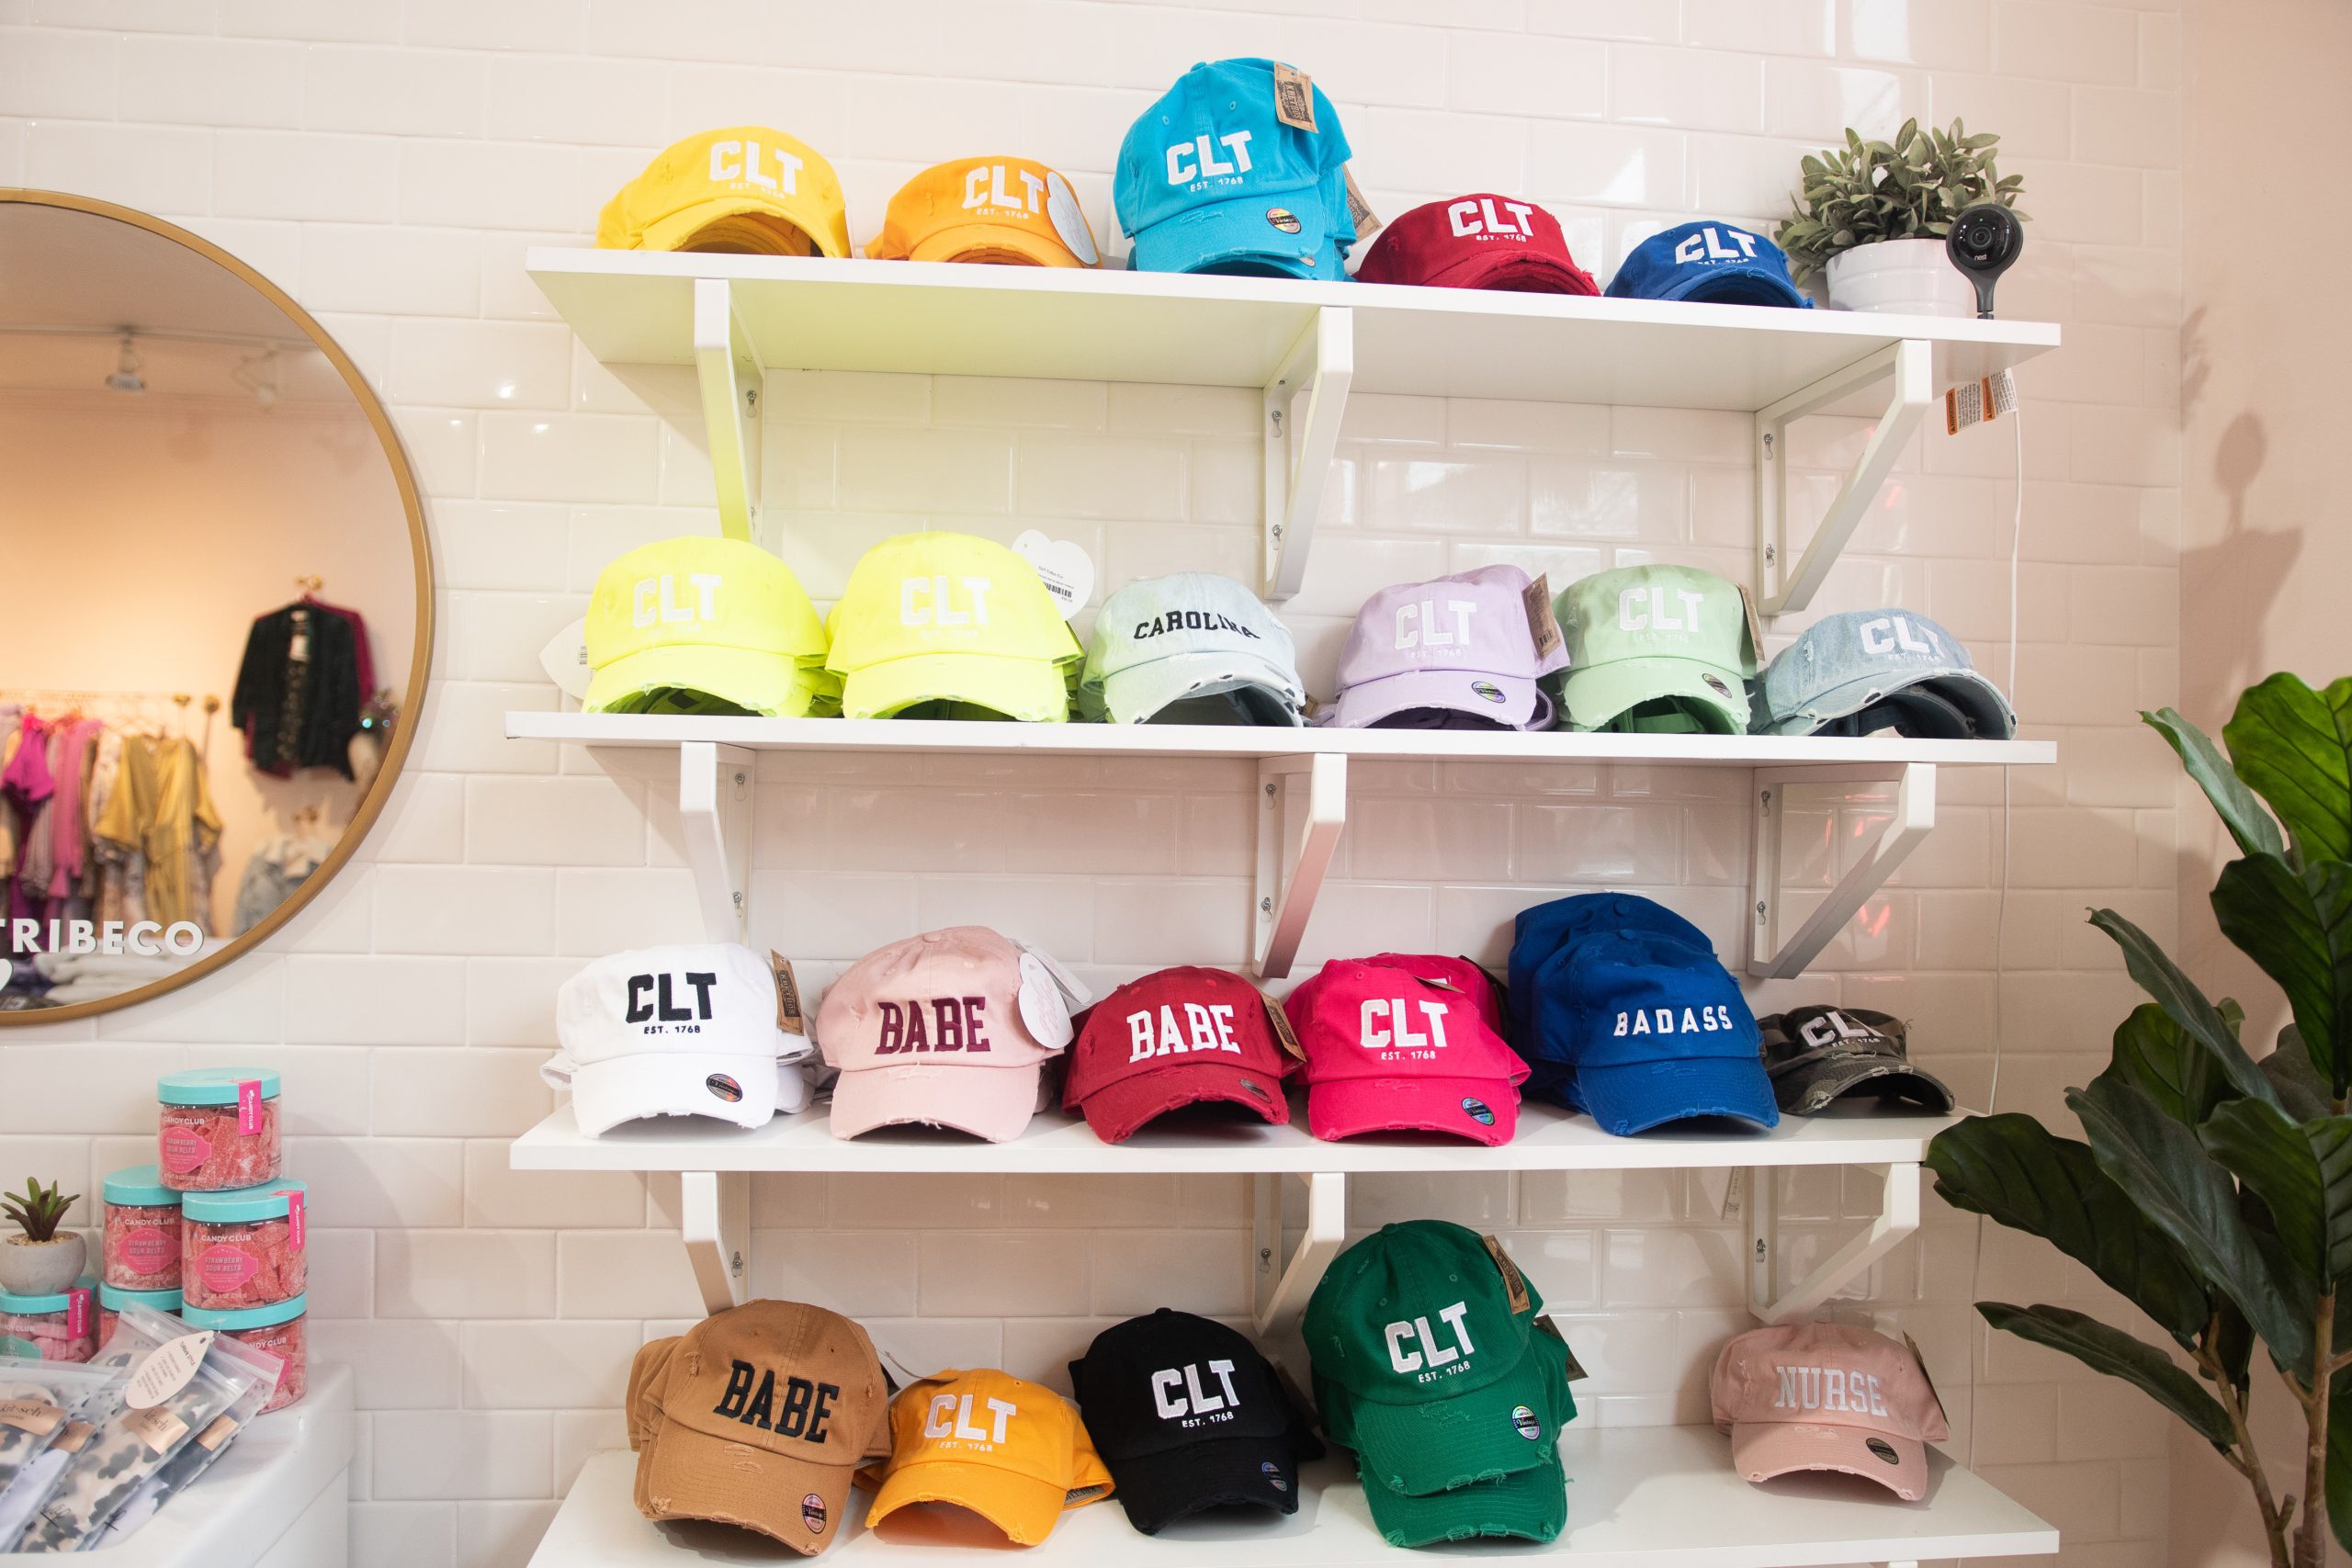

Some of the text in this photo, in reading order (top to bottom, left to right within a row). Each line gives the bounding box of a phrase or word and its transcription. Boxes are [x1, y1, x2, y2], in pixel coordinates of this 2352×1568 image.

[709, 140, 803, 197] CLT
[1166, 130, 1252, 186] CLT
[961, 164, 1045, 215] CLT
[1190, 176, 1244, 192] EST. 1768
[1004, 210, 1030, 220] 1768
[1447, 198, 1534, 237] CLT
[1675, 227, 1758, 265] CLT
[631, 572, 723, 628] CLT
[900, 575, 992, 626] CLT
[1619, 587, 1705, 632] CLT
[1395, 599, 1477, 650] CLT
[0, 919, 204, 956] RIBECO
[626, 972, 717, 1023] CLT
[1613, 1005, 1733, 1036] BADASS
[643, 1025, 701, 1034] EST. 1768
[875, 996, 990, 1055] BABE
[1126, 1003, 1241, 1064] BABE
[1360, 998, 1449, 1048] CLT
[1801, 1010, 1885, 1047] CL
[1381, 1050, 1436, 1060] EST. 1768
[201, 1234, 252, 1243] CANDY CLUB
[267, 1337, 287, 1347] CLUB
[1385, 1301, 1475, 1373] CLT
[1151, 1359, 1240, 1419] CLT
[1418, 1360, 1471, 1383] EST. 1768
[1774, 1366, 1887, 1417] NURSE
[713, 1359, 840, 1443] BABE
[924, 1394, 1016, 1444] CLT
[1182, 1411, 1235, 1427] EST. 1768
[967, 1442, 992, 1452] 1768
